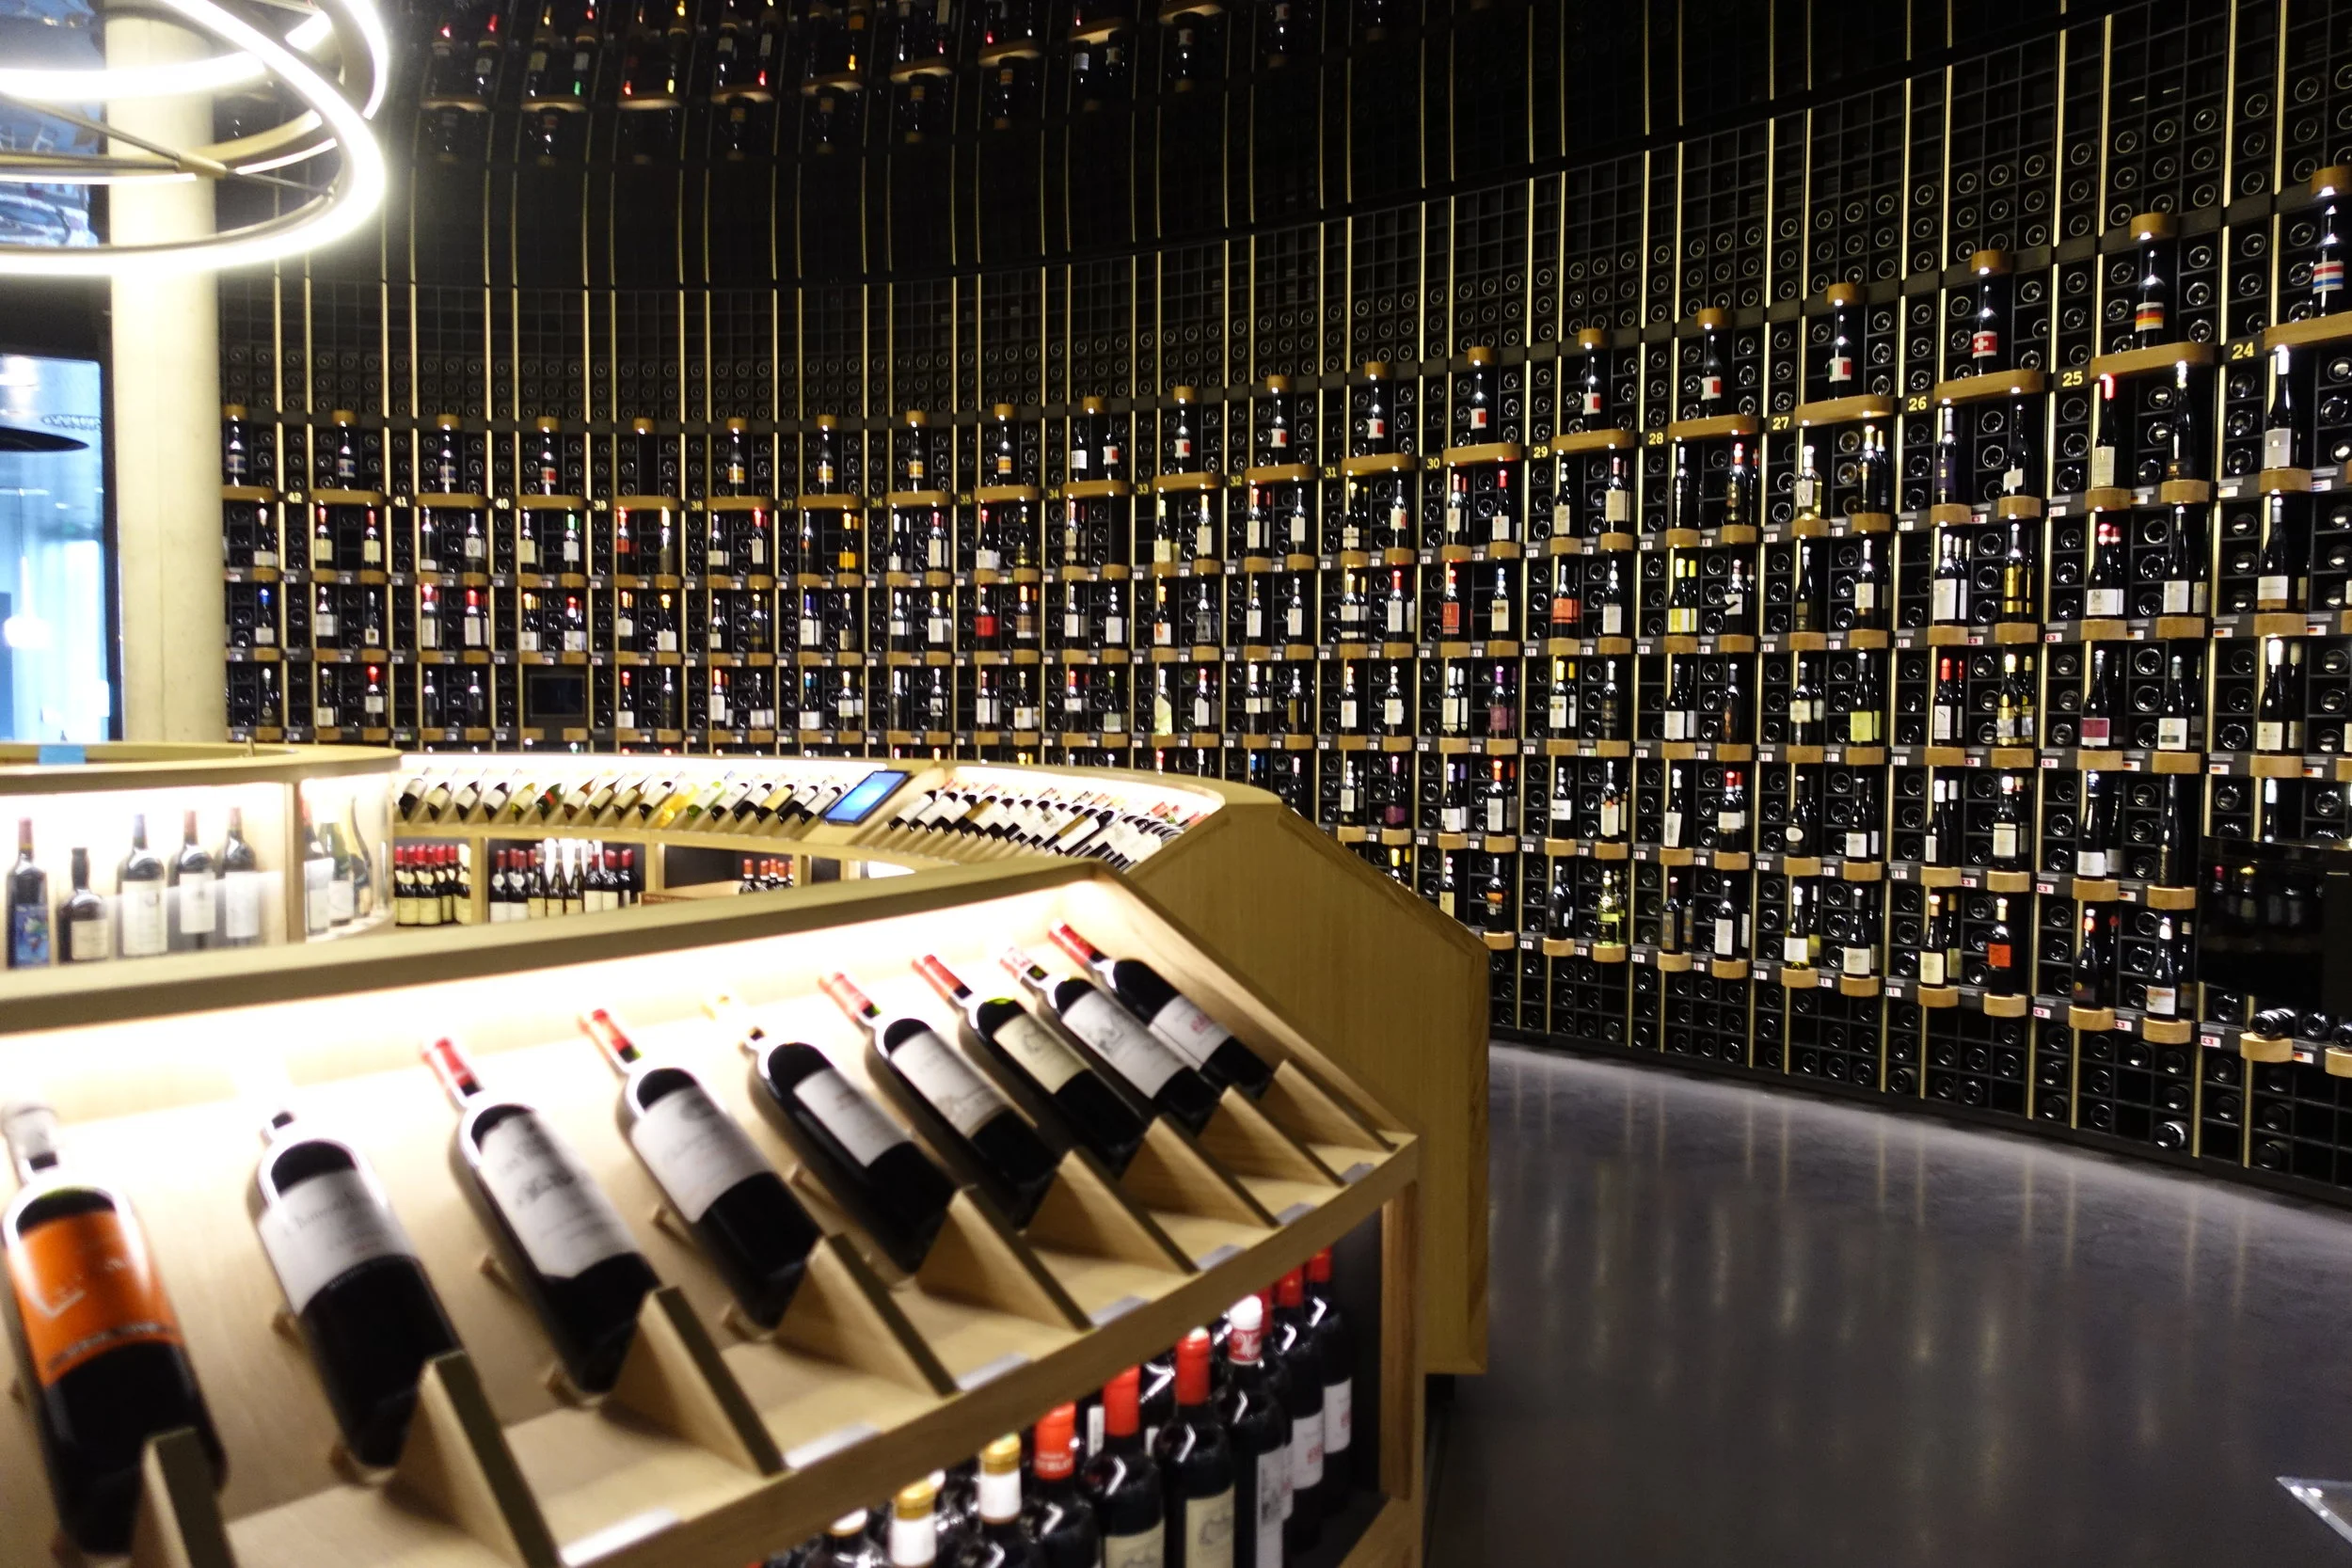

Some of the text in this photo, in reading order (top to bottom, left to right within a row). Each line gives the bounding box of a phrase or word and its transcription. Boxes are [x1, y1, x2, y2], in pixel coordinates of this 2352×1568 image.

[2233, 342, 2254, 360] 24
[2061, 370, 2083, 387] 25
[1908, 395, 1927, 412] 26
[1772, 416, 1789, 431] 27
[1647, 432, 1664, 446] 28
[1533, 445, 1549, 459] 29
[1426, 457, 1440, 470] 30
[1325, 466, 1338, 479] 31
[1230, 474, 1243, 487] 32
[1048, 488, 1060, 499] 34
[1136, 482, 1150, 495] 33
[781, 499, 794, 511] 37
[870, 497, 883, 508] 36
[960, 493, 972, 505] 35
[594, 500, 608, 512] 39
[691, 500, 704, 512] 38
